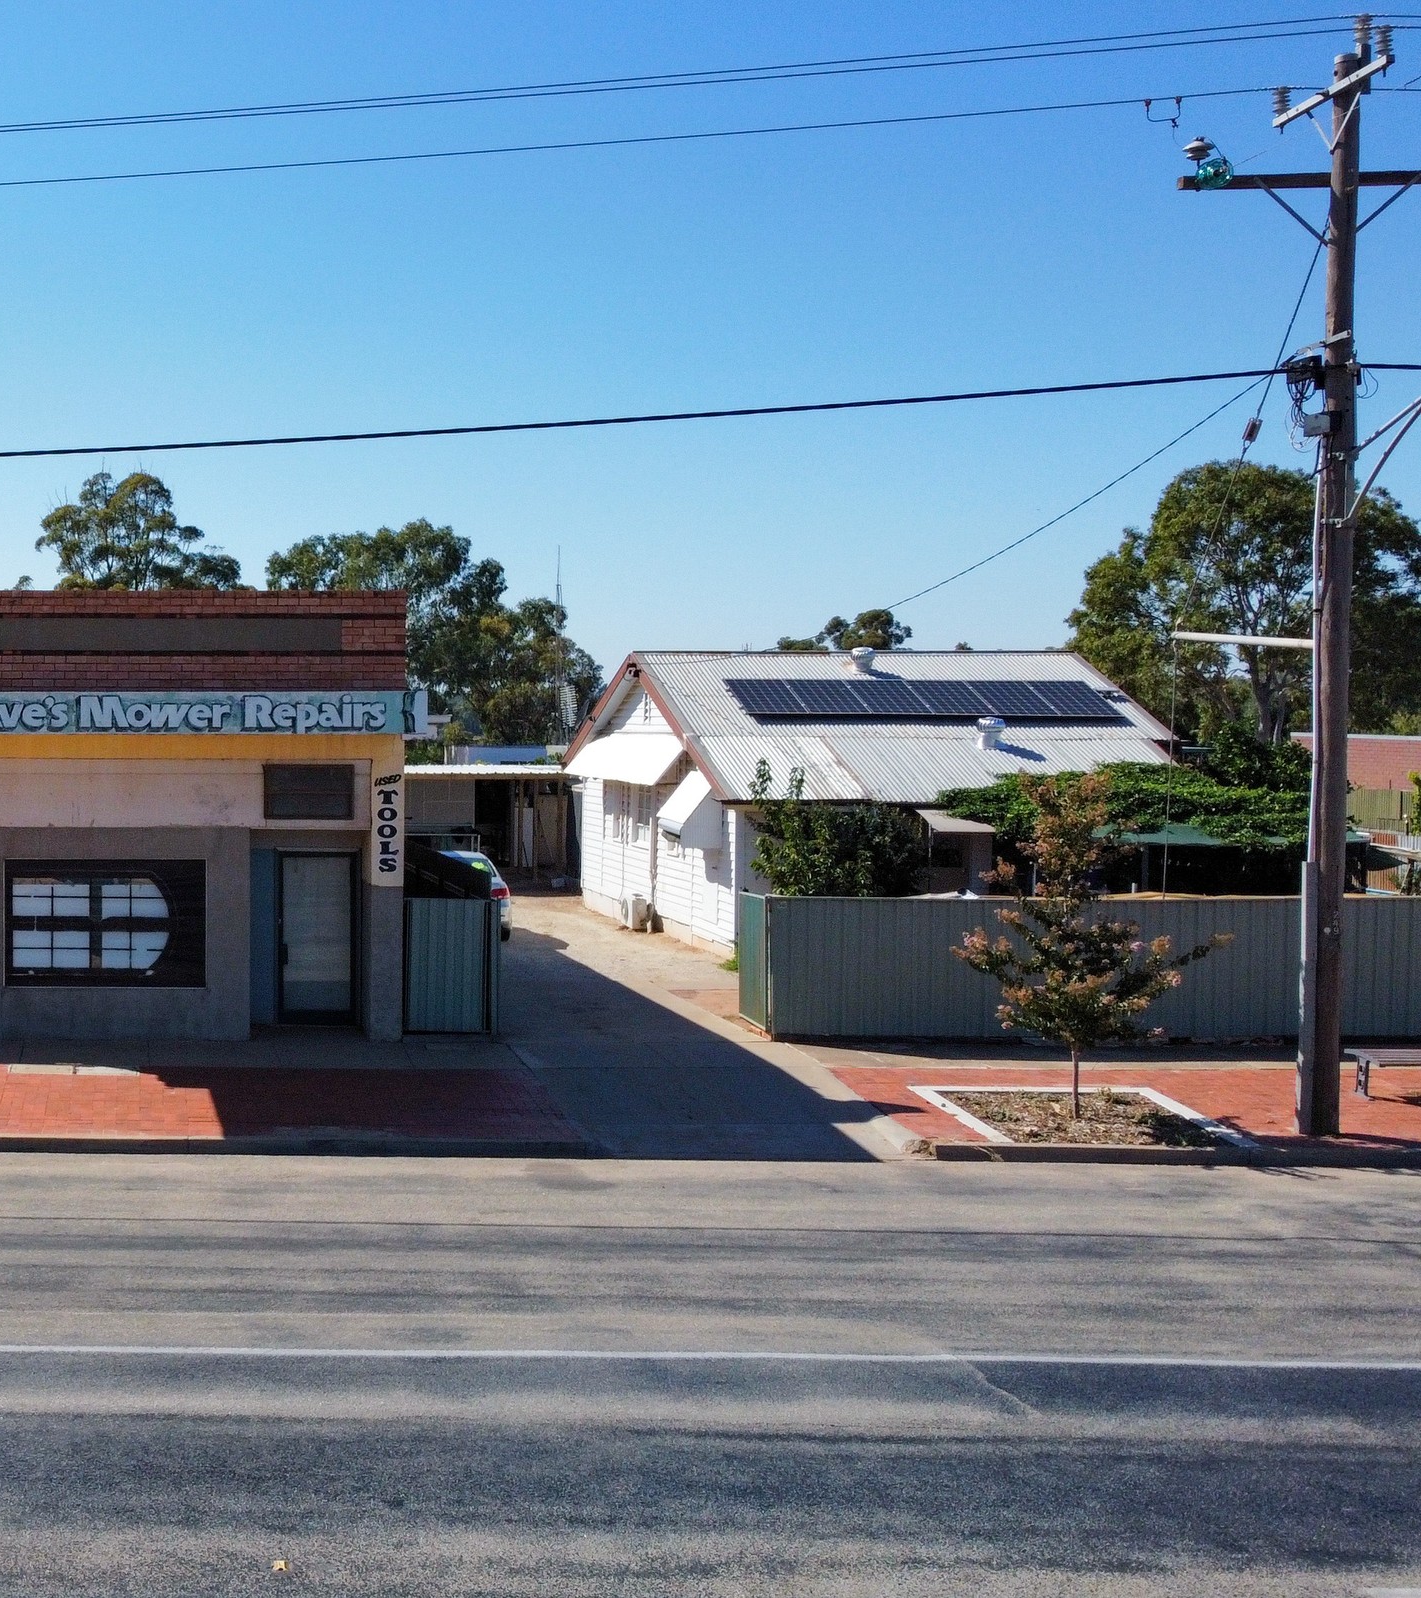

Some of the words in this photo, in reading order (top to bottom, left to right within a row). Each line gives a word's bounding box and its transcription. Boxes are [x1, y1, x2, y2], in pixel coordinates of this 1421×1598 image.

[78, 695, 230, 732] Mower
[242, 694, 386, 734] Repairs
[374, 774, 402, 787] USED
[377, 789, 399, 873] TOOLS
